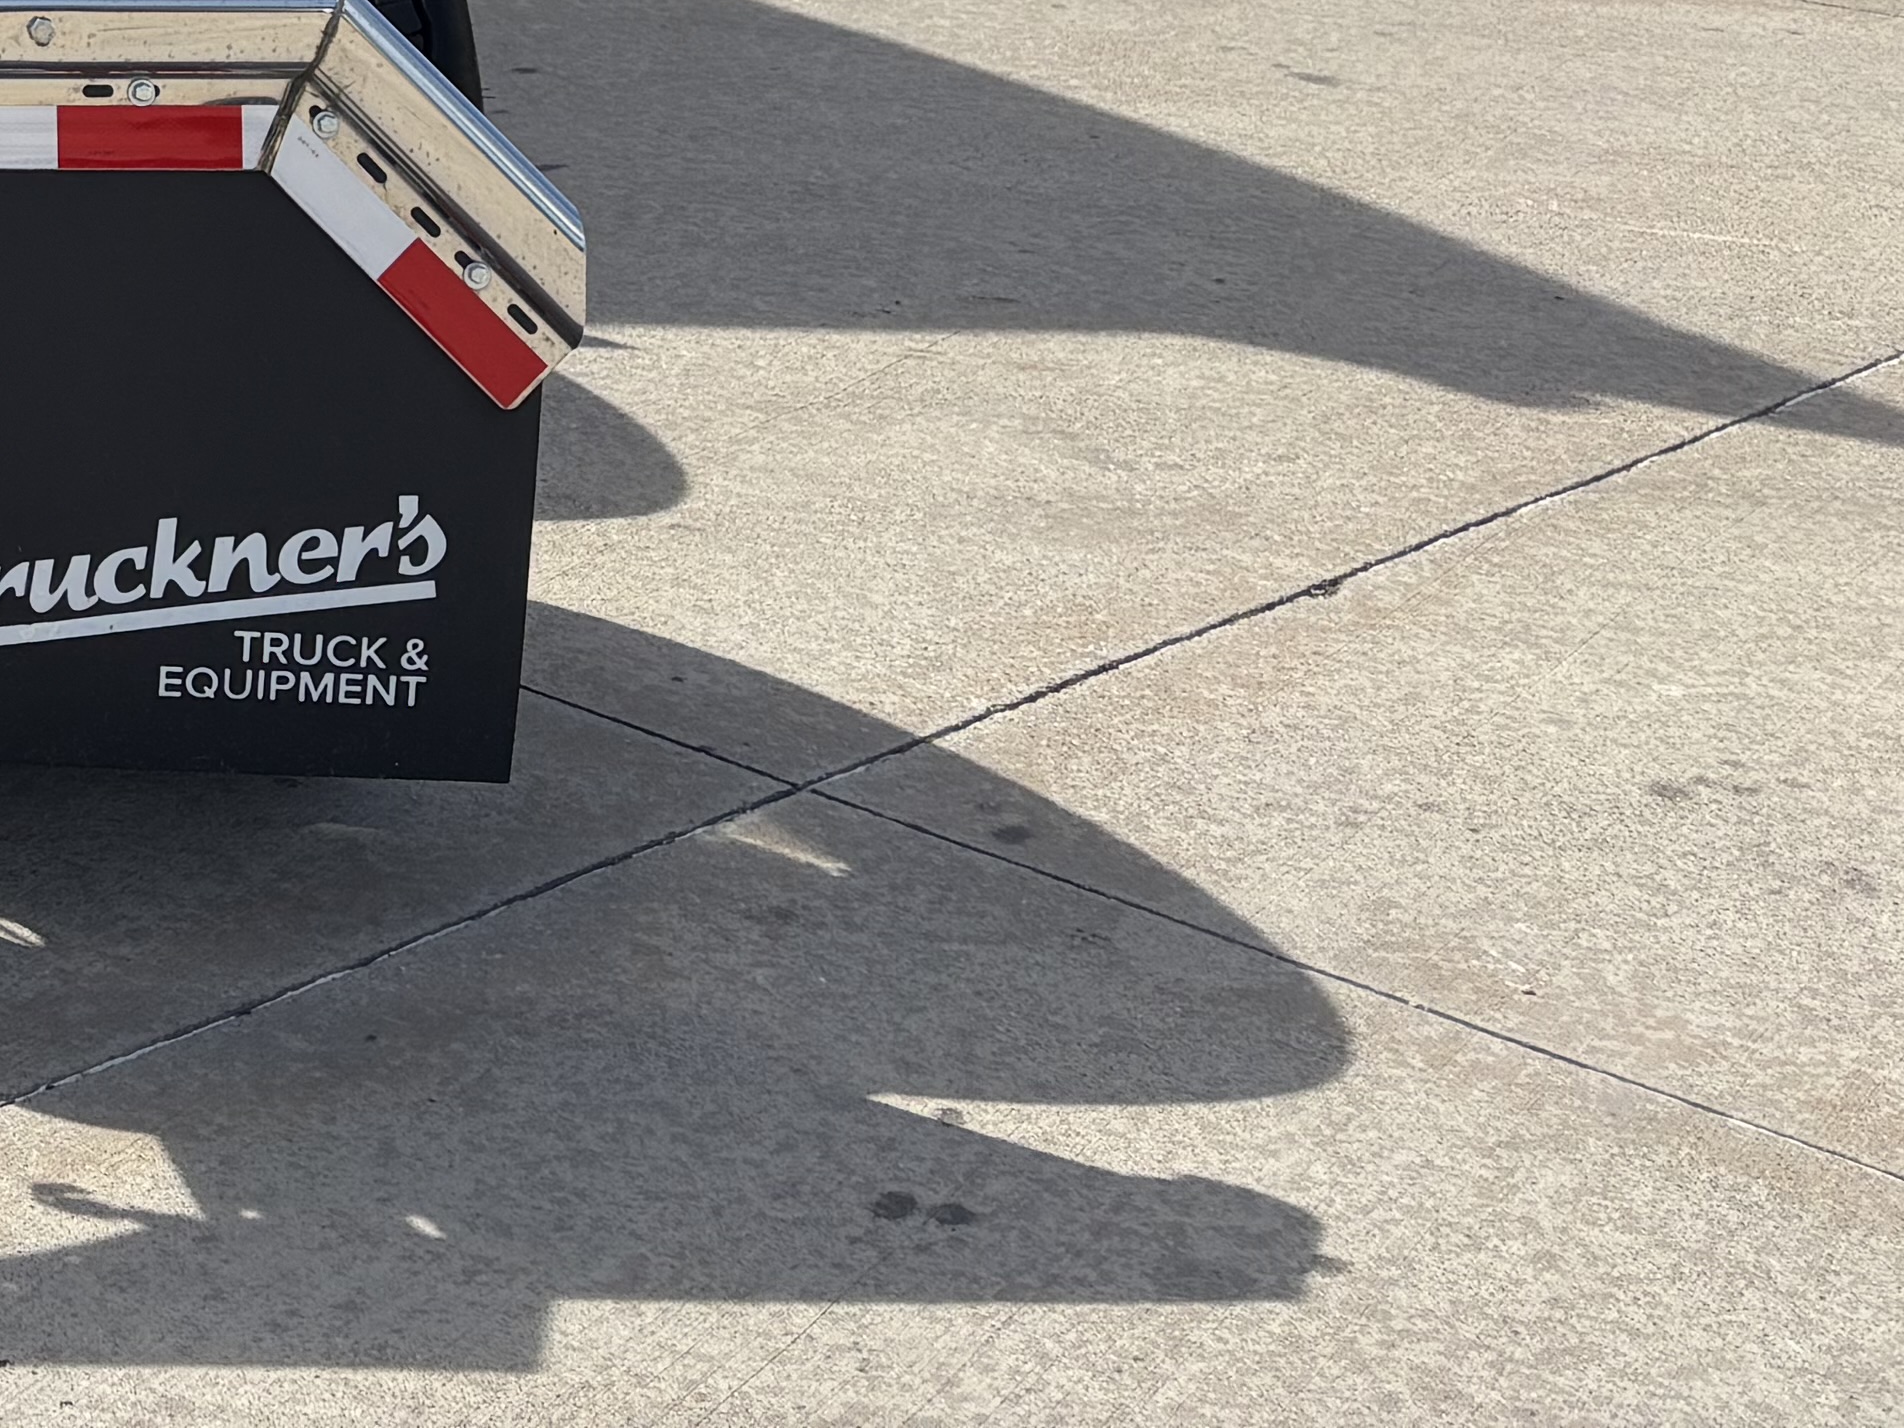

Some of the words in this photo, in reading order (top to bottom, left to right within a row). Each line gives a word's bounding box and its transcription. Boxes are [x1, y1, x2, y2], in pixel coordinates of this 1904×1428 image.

[233, 630, 387, 669] TRUCK
[400, 638, 429, 671] &
[158, 665, 427, 707] EQUIPMENT
